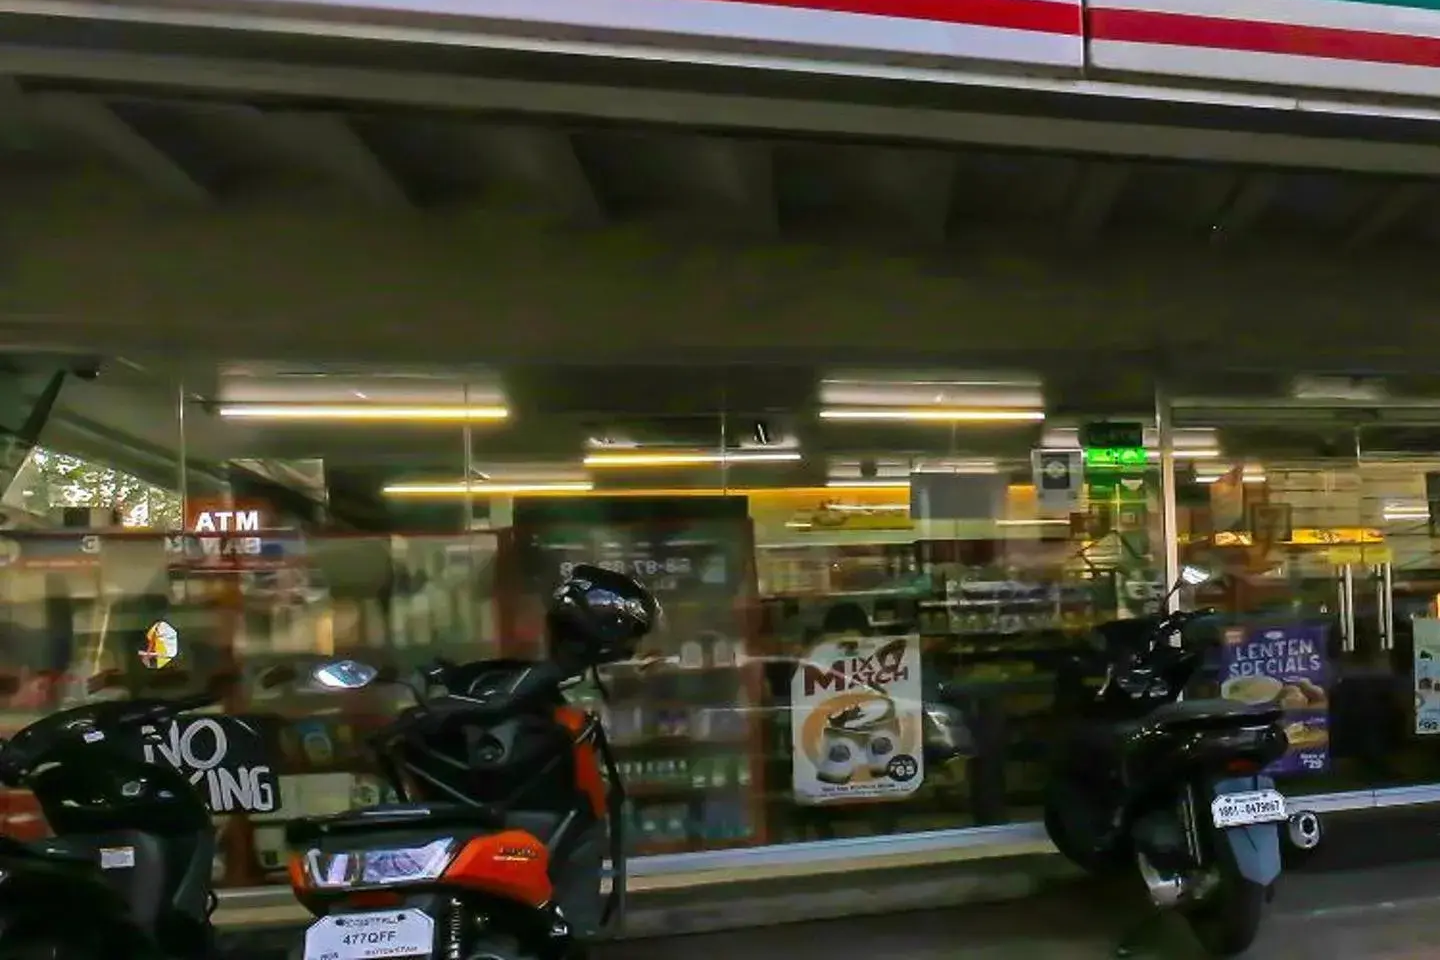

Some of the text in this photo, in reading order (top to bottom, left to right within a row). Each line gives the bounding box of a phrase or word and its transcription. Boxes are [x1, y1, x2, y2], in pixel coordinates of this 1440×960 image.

[194, 510, 259, 532] ATM
[1235, 639, 1313, 662] LENTEN
[1228, 654, 1322, 678] SPECIALS
[188, 766, 274, 812] ING
[342, 931, 397, 946] 477QFF
